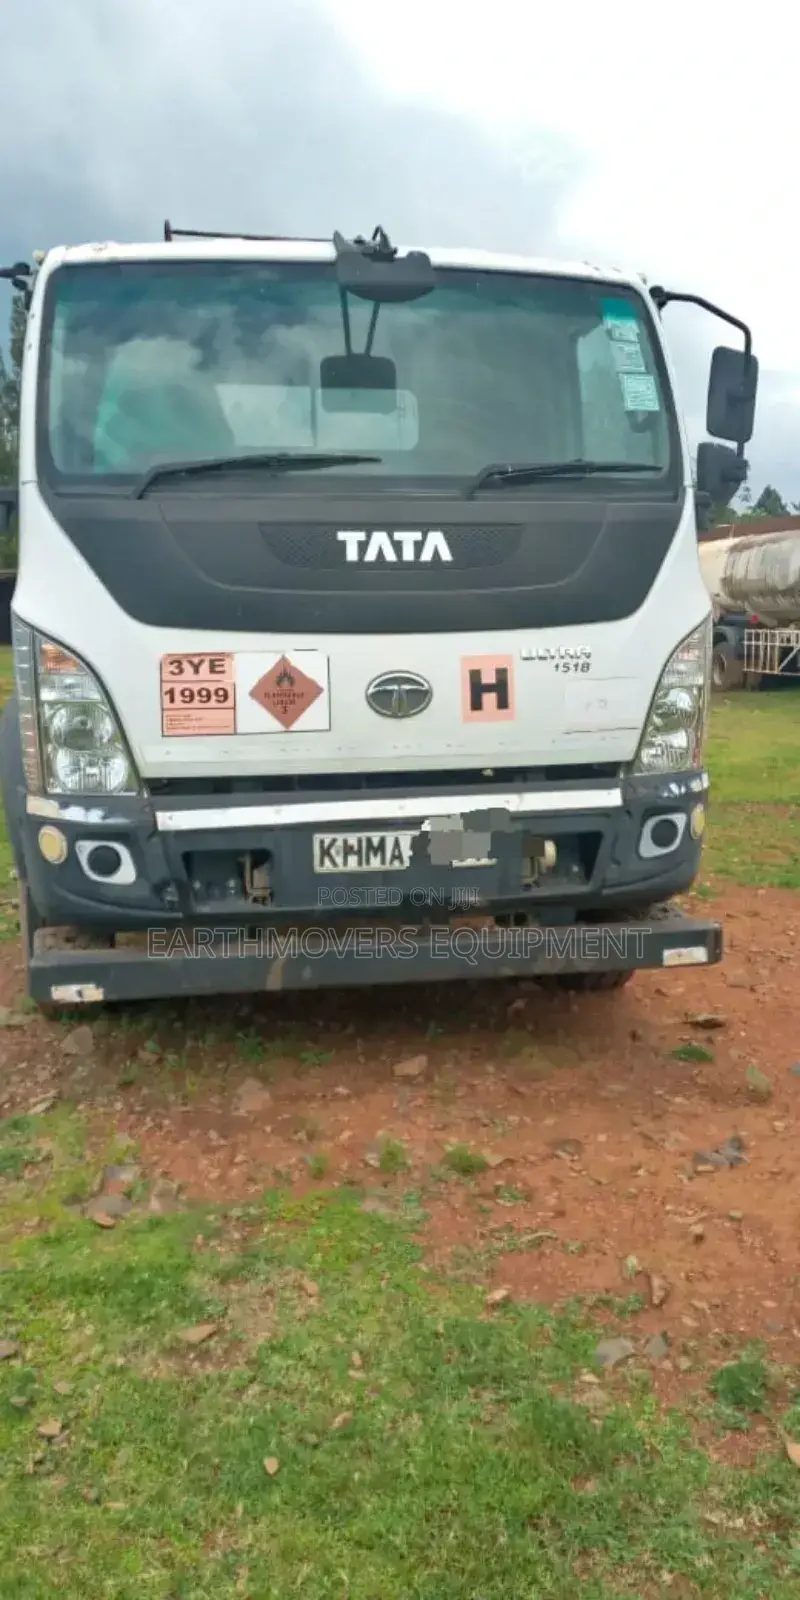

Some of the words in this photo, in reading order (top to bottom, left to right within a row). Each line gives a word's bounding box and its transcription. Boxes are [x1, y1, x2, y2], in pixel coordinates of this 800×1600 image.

[337, 531, 453, 562] TATA
[519, 645, 592, 661] ULTRA
[168, 658, 227, 676] 3YE
[553, 662, 591, 673] 1518
[164, 687, 230, 704] 1999
[468, 667, 510, 711] H
